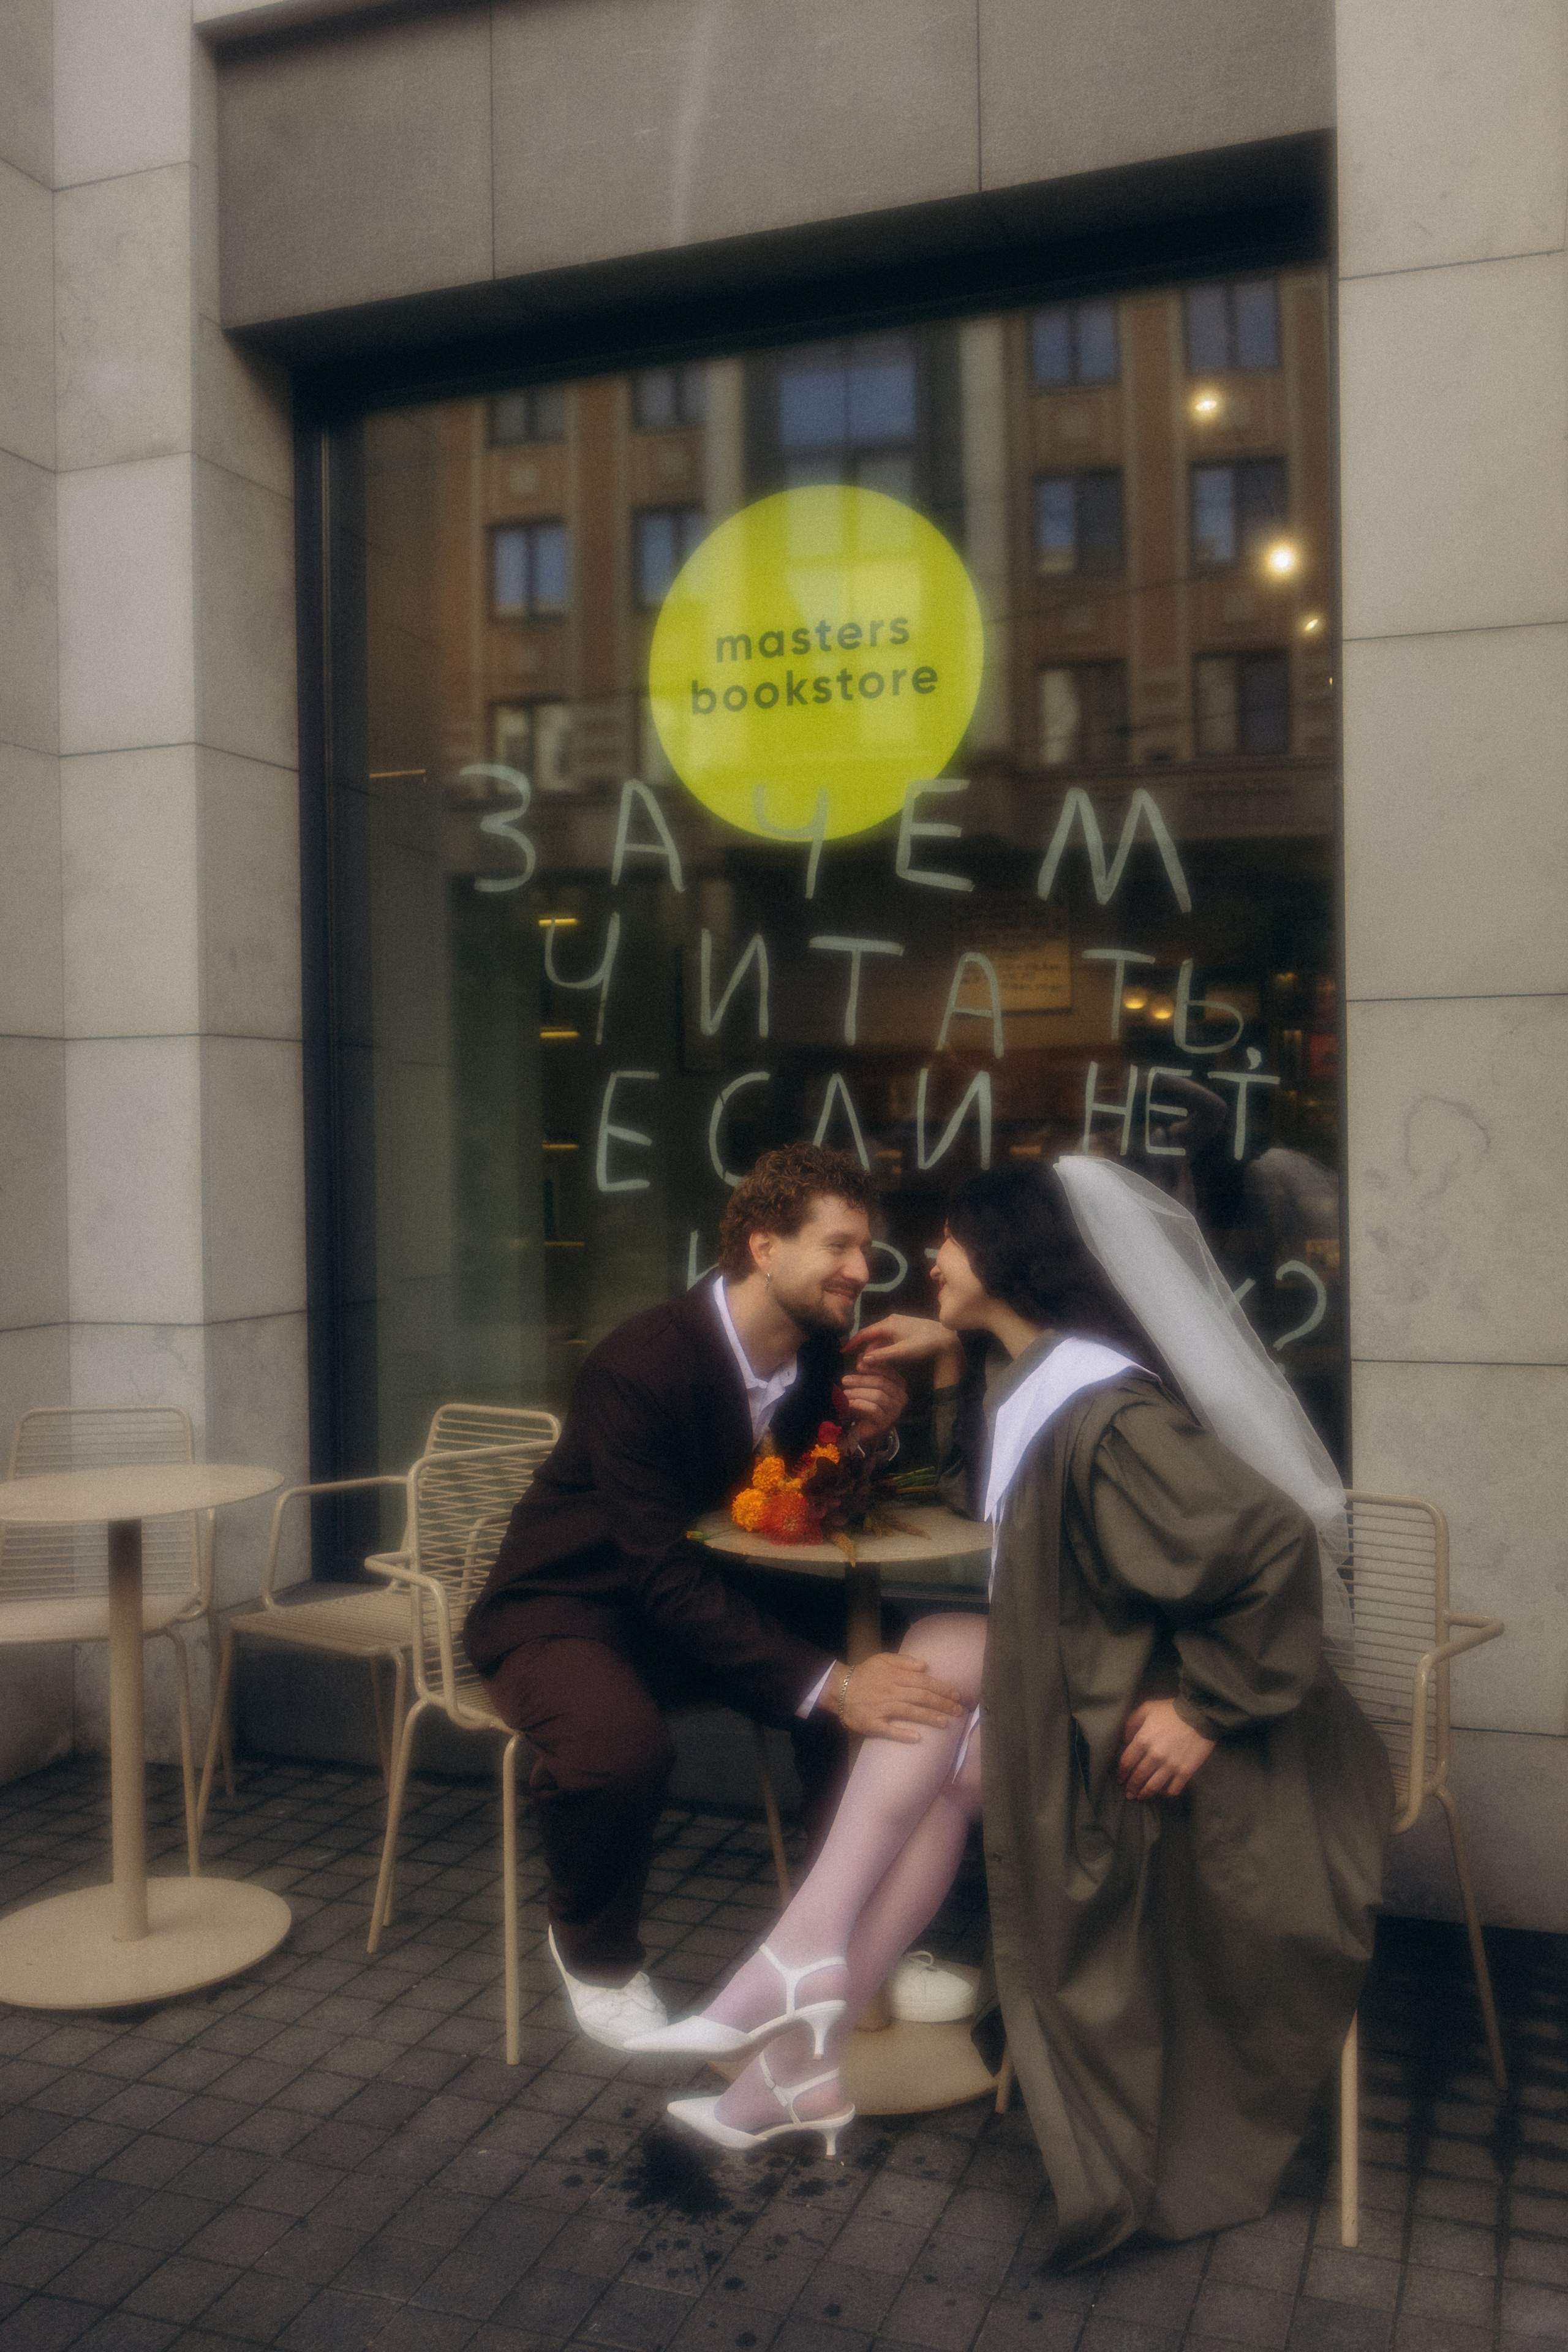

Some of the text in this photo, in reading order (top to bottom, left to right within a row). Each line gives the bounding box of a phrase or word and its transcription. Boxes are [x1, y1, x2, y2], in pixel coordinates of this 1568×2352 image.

[716, 616, 910, 663] masters
[691, 665, 938, 715] bookstore
[459, 763, 1193, 913] ЗАЧЕМ
[595, 1061, 1281, 1191] ЕСЛИ НЕТ
